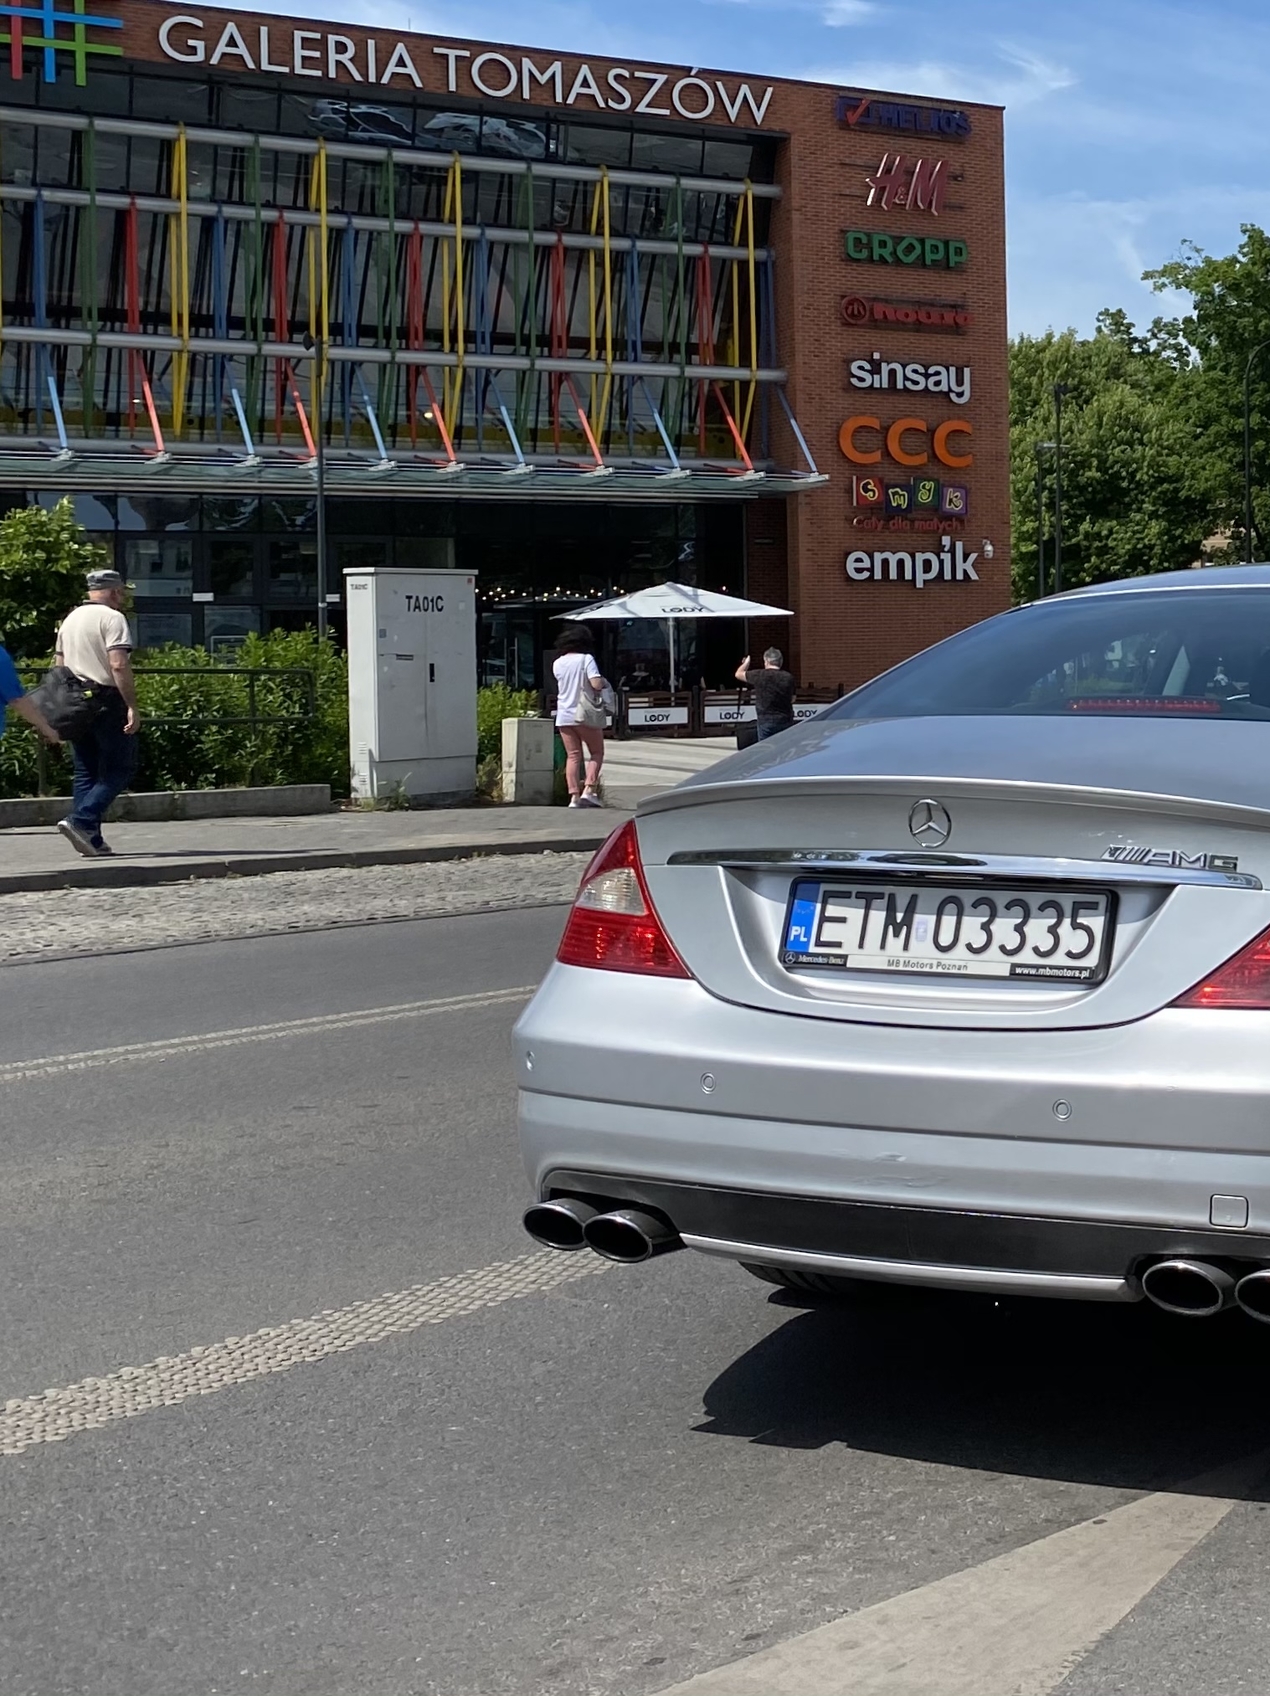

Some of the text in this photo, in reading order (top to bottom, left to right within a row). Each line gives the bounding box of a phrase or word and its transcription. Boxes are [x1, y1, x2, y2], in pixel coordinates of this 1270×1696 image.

[158, 15, 774, 126] GALERIA TOMASZÓW
[879, 103, 971, 137] HELIOS
[865, 152, 950, 217] H&M
[845, 230, 968, 267] CROPP
[850, 352, 971, 404] sinsay
[839, 415, 974, 468] CCC
[890, 516, 910, 530] dla
[846, 535, 979, 588] empik
[405, 595, 444, 612] TA01C
[644, 713, 670, 722] LODY
[719, 711, 745, 720] LODY
[1143, 848, 1239, 871] AMG
[789, 927, 808, 942] PL
[814, 890, 1099, 959] ETM 03335
[887, 959, 968, 971] MB Motors Poznań
[1015, 967, 1090, 979] www.mbmotors.pl
